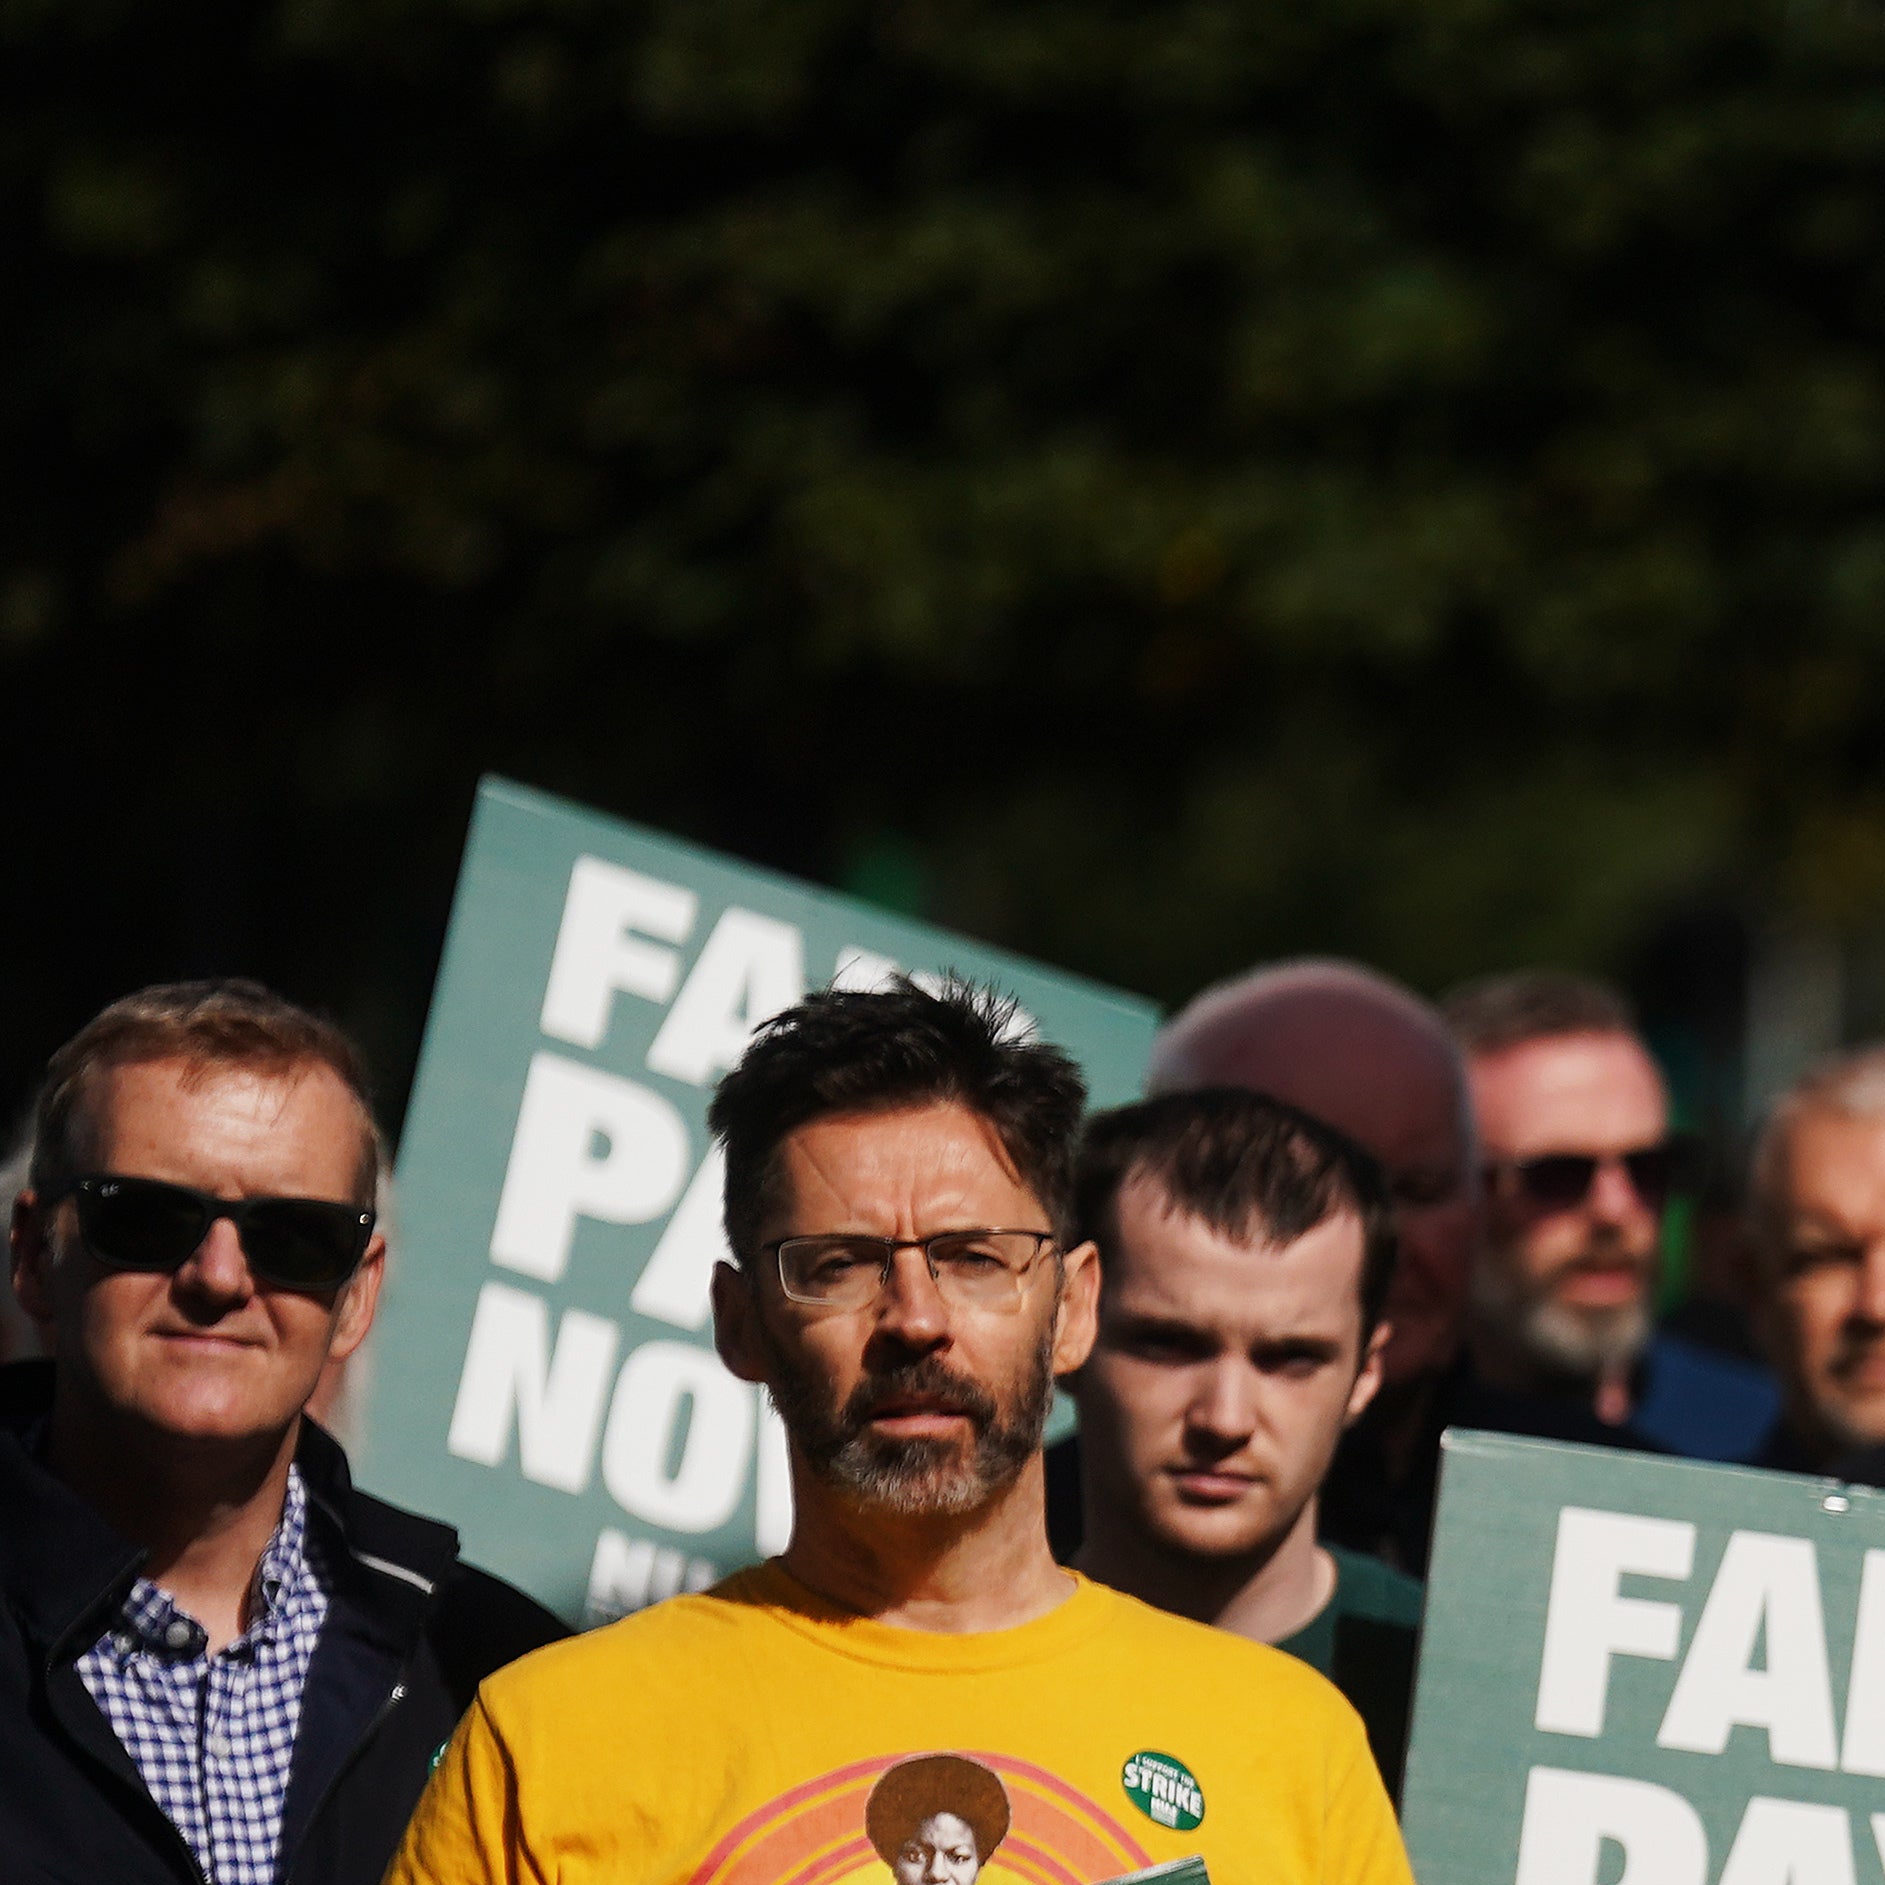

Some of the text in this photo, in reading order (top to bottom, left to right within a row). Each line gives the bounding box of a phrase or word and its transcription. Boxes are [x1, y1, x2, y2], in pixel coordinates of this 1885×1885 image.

[540, 854, 1040, 1087] FA
[448, 1281, 795, 1558] NO
[1123, 1763, 1202, 1819] STRIKE
